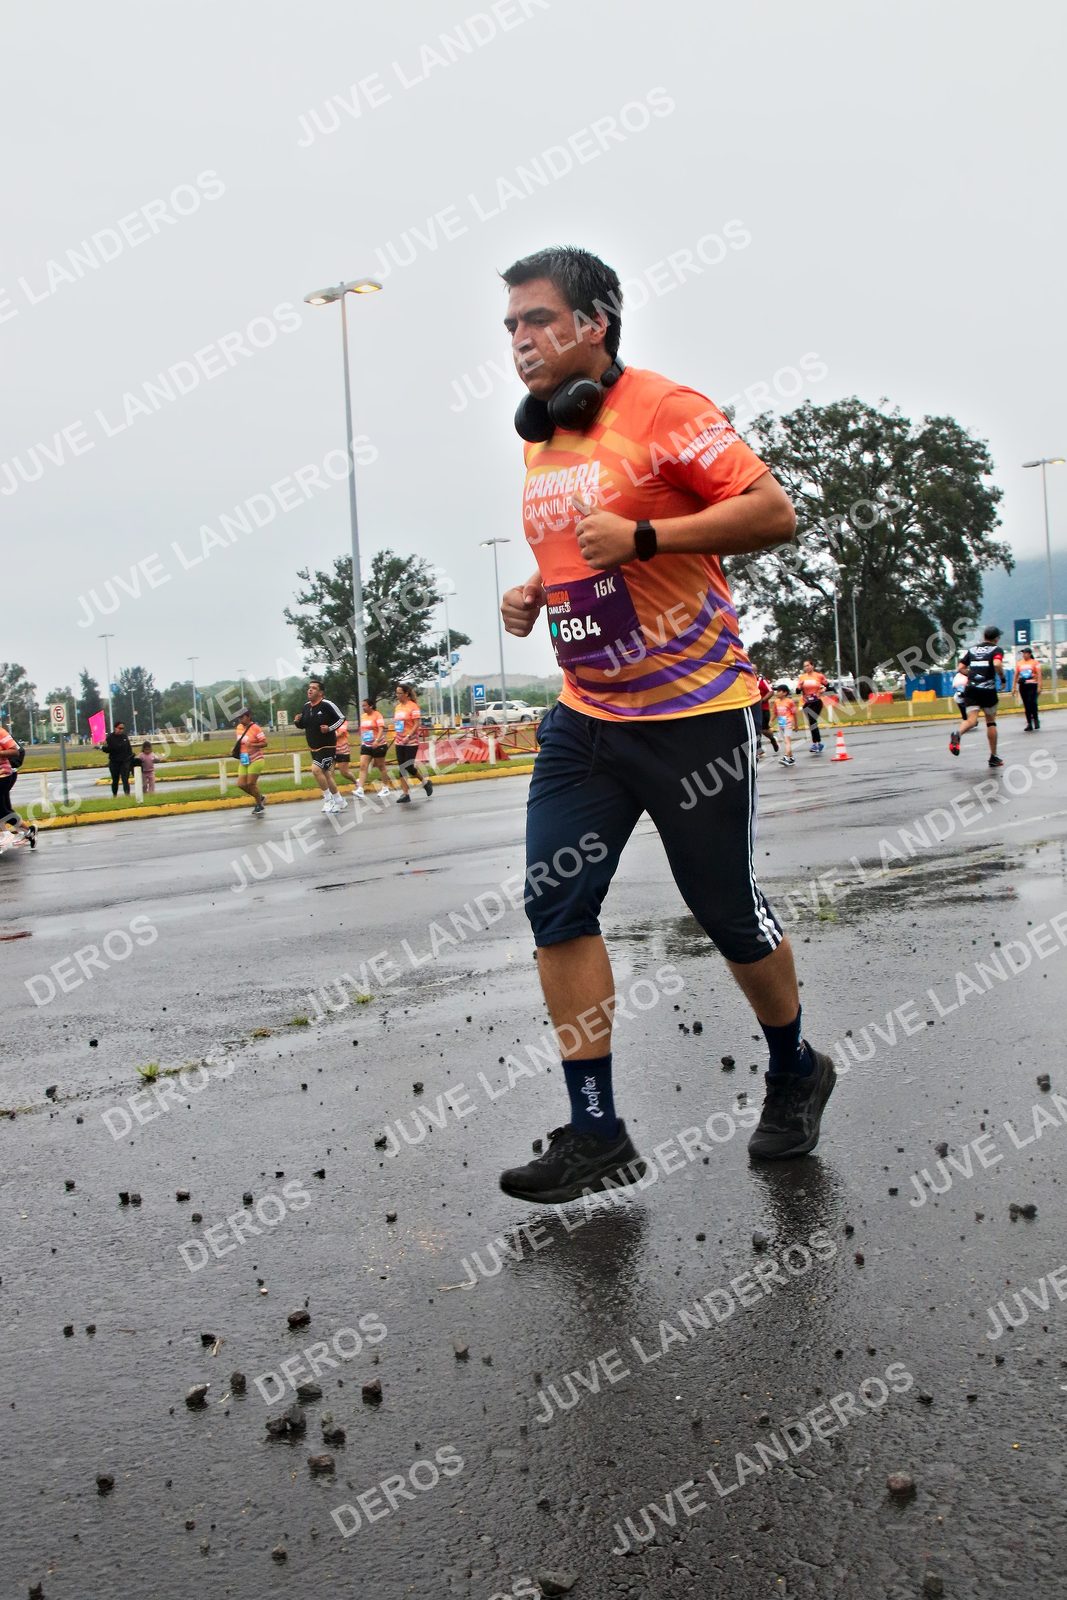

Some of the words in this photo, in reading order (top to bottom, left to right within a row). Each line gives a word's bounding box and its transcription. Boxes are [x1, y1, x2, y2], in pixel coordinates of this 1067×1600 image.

[525, 460, 600, 502] CARRERA
[593, 577, 616, 598] 15K
[560, 615, 602, 643] 684
[1017, 630, 1027, 642] E
